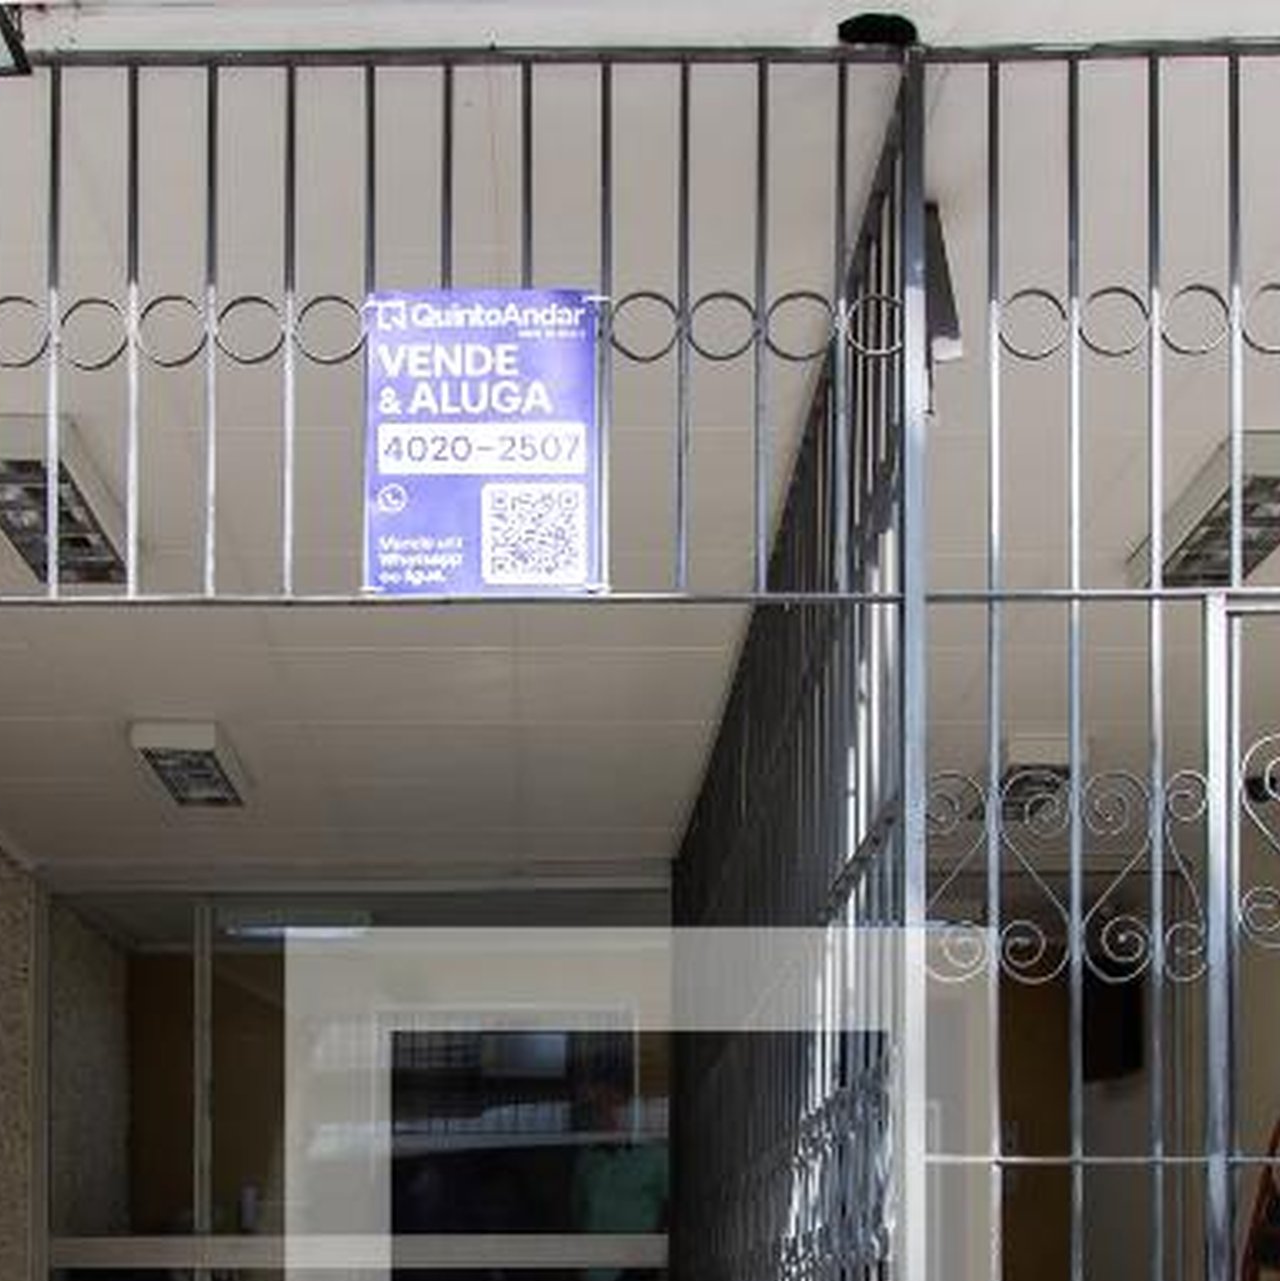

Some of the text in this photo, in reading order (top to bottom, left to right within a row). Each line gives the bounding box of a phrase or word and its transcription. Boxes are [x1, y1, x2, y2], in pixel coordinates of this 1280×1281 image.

[411, 301, 586, 329] QuintoAndar
[378, 344, 519, 377] VENDE
[378, 379, 553, 415] & ALUGA
[383, 434, 580, 462] 4020-2507
